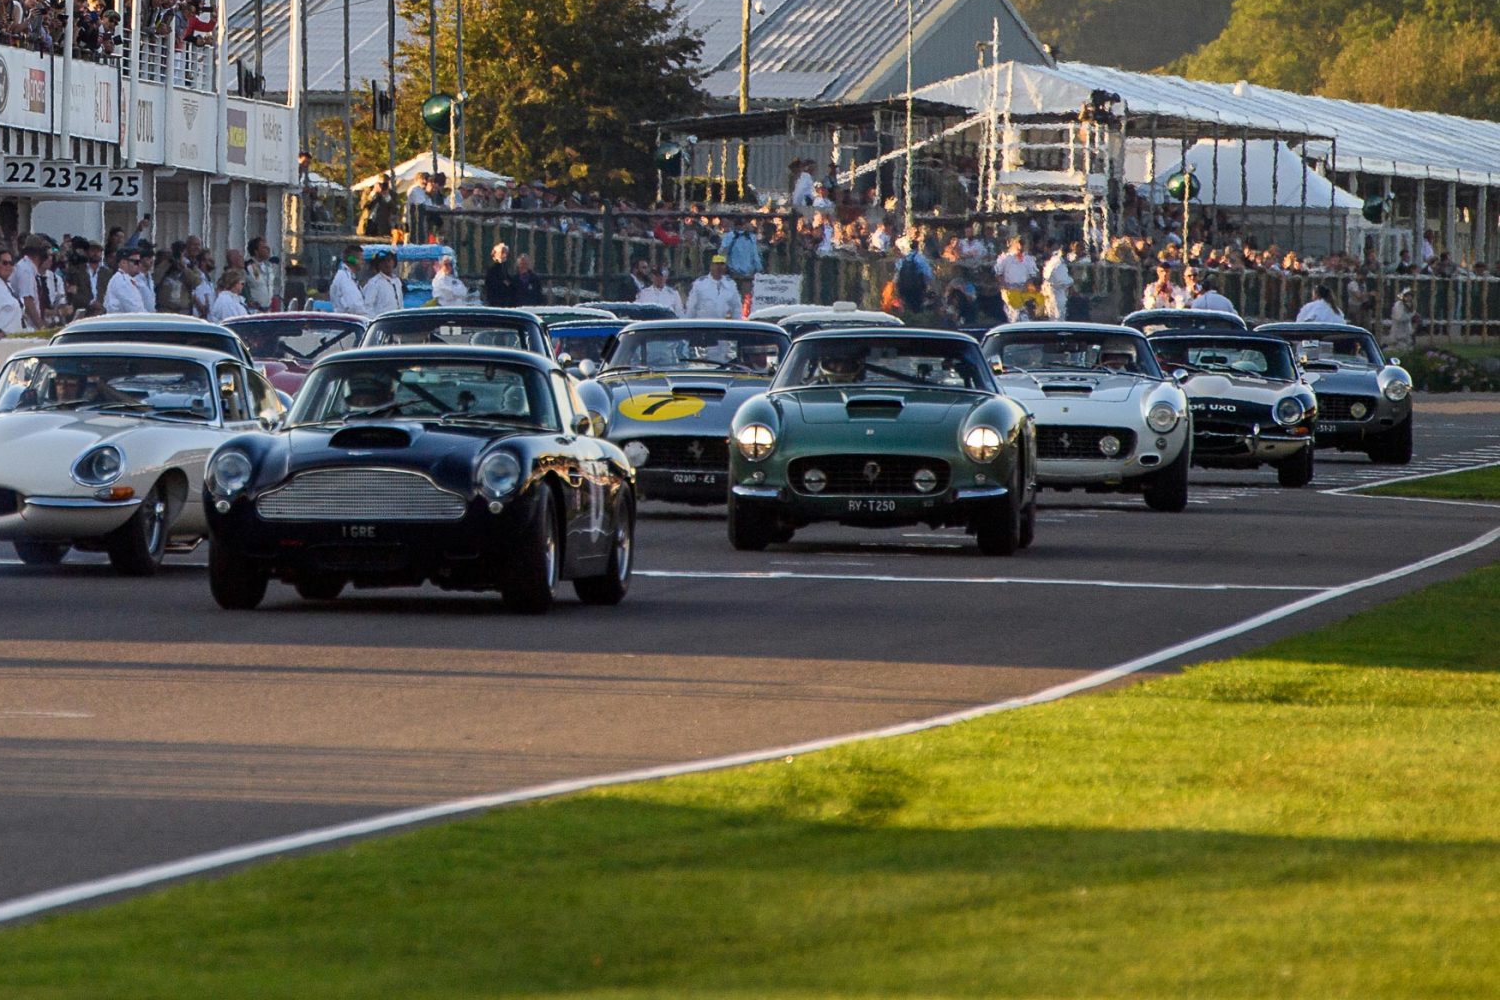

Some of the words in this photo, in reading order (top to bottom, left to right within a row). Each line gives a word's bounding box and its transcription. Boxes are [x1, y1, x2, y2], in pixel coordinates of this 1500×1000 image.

[136, 98, 155, 144] OTUL
[5, 162, 36, 183] 22
[42, 166, 72, 188] 23
[74, 171, 104, 192] 24
[111, 176, 139, 196] 25
[641, 393, 689, 416] 7
